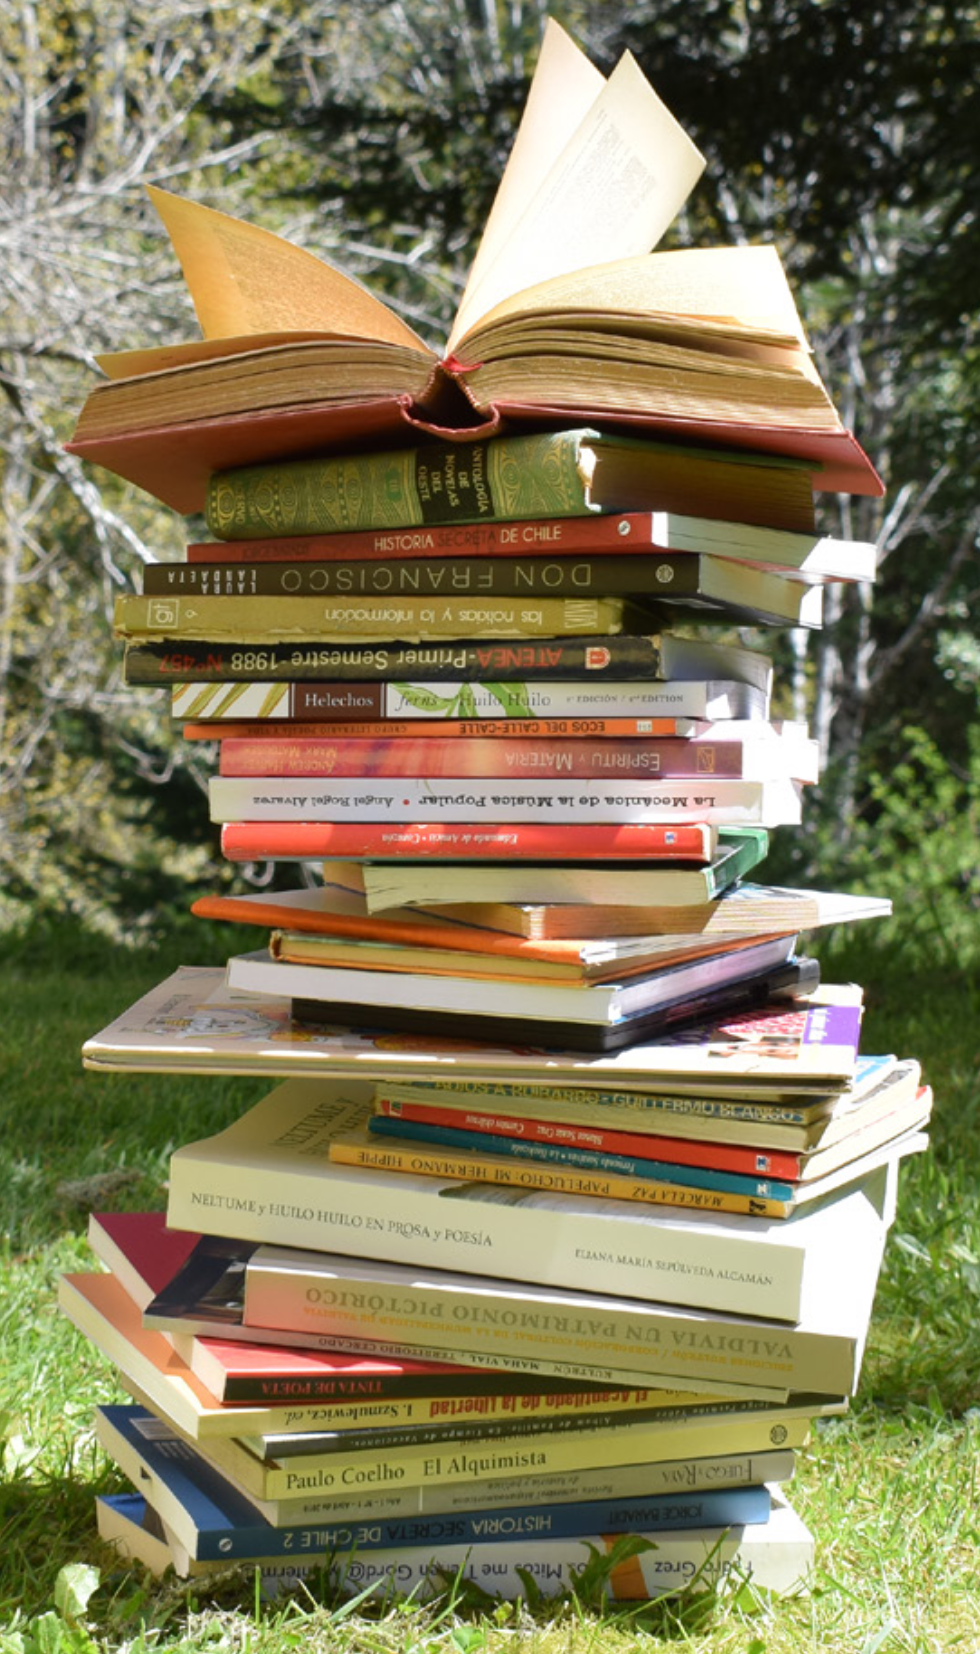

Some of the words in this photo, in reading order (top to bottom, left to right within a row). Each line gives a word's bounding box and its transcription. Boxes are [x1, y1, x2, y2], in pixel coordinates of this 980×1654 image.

[418, 466, 431, 502] OESTE
[431, 471, 442, 494] DEL
[445, 454, 458, 508] NOVELAS
[458, 471, 469, 489] DE
[472, 446, 488, 513] ANTOLOGÍA
[374, 533, 435, 551] HISTORIA
[436, 530, 497, 548] SECRETA
[500, 528, 518, 543] DE
[522, 525, 562, 542] CHILE
[168, 570, 257, 583] LANDAETA
[281, 566, 494, 591] FRANCISCO
[515, 564, 591, 587] DON
[202, 582, 257, 594] LAURA
[325, 608, 413, 622] información
[420, 609, 435, 621] la
[442, 608, 453, 621] y
[459, 609, 514, 625] noticias
[522, 610, 543, 625] las
[305, 692, 373, 707] Helechos
[394, 693, 437, 712] ferns
[460, 692, 502, 706] Huilo
[508, 691, 551, 707] Huilo
[577, 694, 617, 703] EDICIÓN
[642, 694, 683, 703] EDITION
[320, 726, 370, 734] LITERARIO
[375, 726, 407, 734] GRUPO
[460, 721, 539, 733] CALLE-CALLE
[547, 721, 567, 732] DEL
[572, 721, 605, 732] ECOS
[306, 746, 338, 758] MARK
[288, 760, 336, 773] ANDREW
[505, 752, 572, 771] MATERIA
[592, 752, 661, 771] ESPÍRITU
[253, 796, 308, 807] Álvarez
[311, 796, 350, 807] Rogel
[353, 796, 394, 807] Ángel
[418, 794, 486, 807] Popular
[491, 796, 553, 807] Música
[557, 796, 575, 807] la
[579, 796, 600, 807] de
[605, 796, 688, 807] Mecánica
[694, 796, 716, 807] La
[495, 1085, 506, 1096] A
[515, 1085, 599, 1104] RUIBARBO
[613, 1094, 714, 1115] GUILLERMO
[719, 1103, 794, 1121] BLANCO
[537, 1125, 555, 1138] Cruz
[555, 1128, 576, 1141] Santa
[357, 1151, 403, 1167] HIPPIE
[411, 1159, 487, 1179] HERMANO
[494, 1168, 511, 1181] MI
[515, 1171, 610, 1195] PAPELUCHO:
[631, 1186, 657, 1198] PAZ
[661, 1189, 725, 1207] MARCELA
[191, 1192, 256, 1213] NELTUME
[257, 1205, 267, 1216] y
[269, 1203, 314, 1221] HUILO
[316, 1209, 362, 1228] HUILO
[365, 1217, 384, 1230] EN
[387, 1220, 431, 1239] PROSA
[432, 1230, 441, 1241] y
[444, 1227, 493, 1247] POESÍA
[574, 1248, 613, 1262] ELIANA
[616, 1254, 653, 1270] MARÍA
[654, 1260, 714, 1279] SEPÚLVEDA
[717, 1270, 773, 1286] ALCAMÁN
[305, 1286, 445, 1319] PICTÓRICO
[452, 1304, 616, 1338] PATRIMONIO
[513, 1330, 572, 1345] CULTURAL
[625, 1326, 661, 1343] UN
[319, 1337, 378, 1353] CERCADO
[380, 1343, 456, 1361] TERRITORIO
[575, 1339, 660, 1356] CORPORACIÓN
[671, 1330, 793, 1359] VALDIVIA
[471, 1353, 499, 1365] VIAL
[501, 1358, 539, 1370] MAHA
[731, 1357, 794, 1371] EDICIONES
[554, 1364, 612, 1380] KULTRÚN
[262, 1381, 311, 1395] POETA
[315, 1381, 336, 1394] DE
[338, 1381, 384, 1394] TINTA
[501, 1395, 517, 1413] la
[521, 1393, 540, 1411] de
[545, 1391, 630, 1409] Acantilado
[635, 1391, 648, 1404] El
[429, 1396, 496, 1418] Libertad
[284, 1411, 303, 1426] ed.
[424, 1432, 437, 1441] de
[285, 1470, 335, 1491] Paulo
[341, 1463, 406, 1485] Coelho
[423, 1458, 441, 1477] El
[446, 1450, 547, 1477] Alquimista
[661, 1464, 697, 1486] RAYA
[704, 1458, 753, 1482] FUEGO
[663, 1503, 703, 1520] JORGE
[387, 1520, 467, 1541] SECRETA
[470, 1514, 551, 1535] HISTORIA
[284, 1532, 293, 1548] 2
[301, 1529, 352, 1547] CHILE
[357, 1526, 381, 1543] DE
[481, 1562, 508, 1576] me
[654, 1560, 697, 1578] Grez
